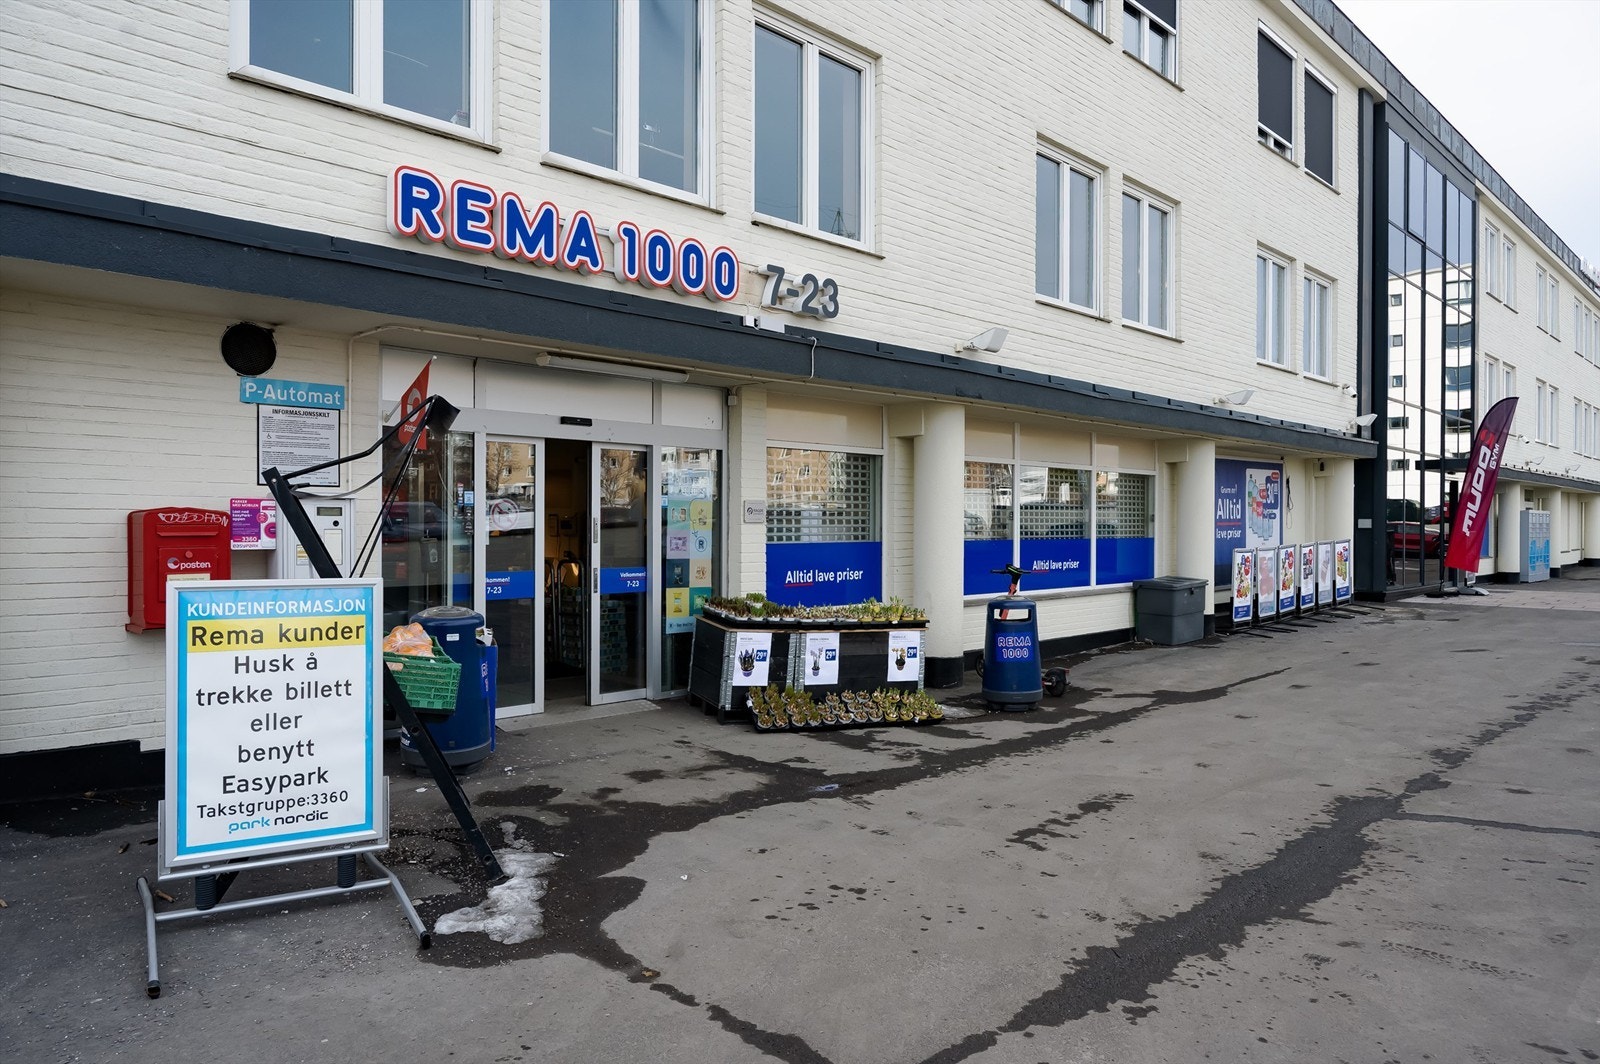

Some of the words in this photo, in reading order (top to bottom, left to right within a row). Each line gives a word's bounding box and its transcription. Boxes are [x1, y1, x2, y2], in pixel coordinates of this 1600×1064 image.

[394, 165, 604, 274] REMA
[617, 220, 740, 302] 1000
[764, 264, 840, 319] 7-23
[245, 382, 341, 405] P-Automat
[272, 409, 330, 418] INFORMASJONSSKILT
[1489, 443, 1500, 470] GYM
[1462, 445, 1491, 536] MUDO
[1216, 498, 1242, 520] Alltid
[1216, 528, 1228, 539] lave
[1227, 527, 1242, 541] priser
[181, 561, 211, 571] posten
[785, 569, 814, 584] Alltid
[815, 569, 835, 582] lave
[837, 567, 864, 584] priser
[1032, 560, 1050, 571] Alltid
[1050, 559, 1062, 570] lave
[1062, 558, 1080, 571] priser
[486, 586, 502, 594] 7-23
[627, 580, 640, 588] 7-23
[187, 599, 365, 617] KUNDEINFORMASJON
[191, 626, 264, 647] Rema
[278, 621, 365, 643] kunder
[997, 636, 1032, 647] REMA
[234, 653, 295, 675] Husk
[305, 651, 318, 671] å
[1002, 647, 1029, 659] 1000
[196, 684, 273, 707] trekke
[285, 679, 352, 701] billett
[250, 712, 303, 732] eller
[238, 739, 315, 764] benytt
[222, 766, 329, 795] Easypark
[197, 790, 349, 819] Takstgruppe:3360
[228, 816, 270, 834] park
[274, 809, 329, 826] nordic
